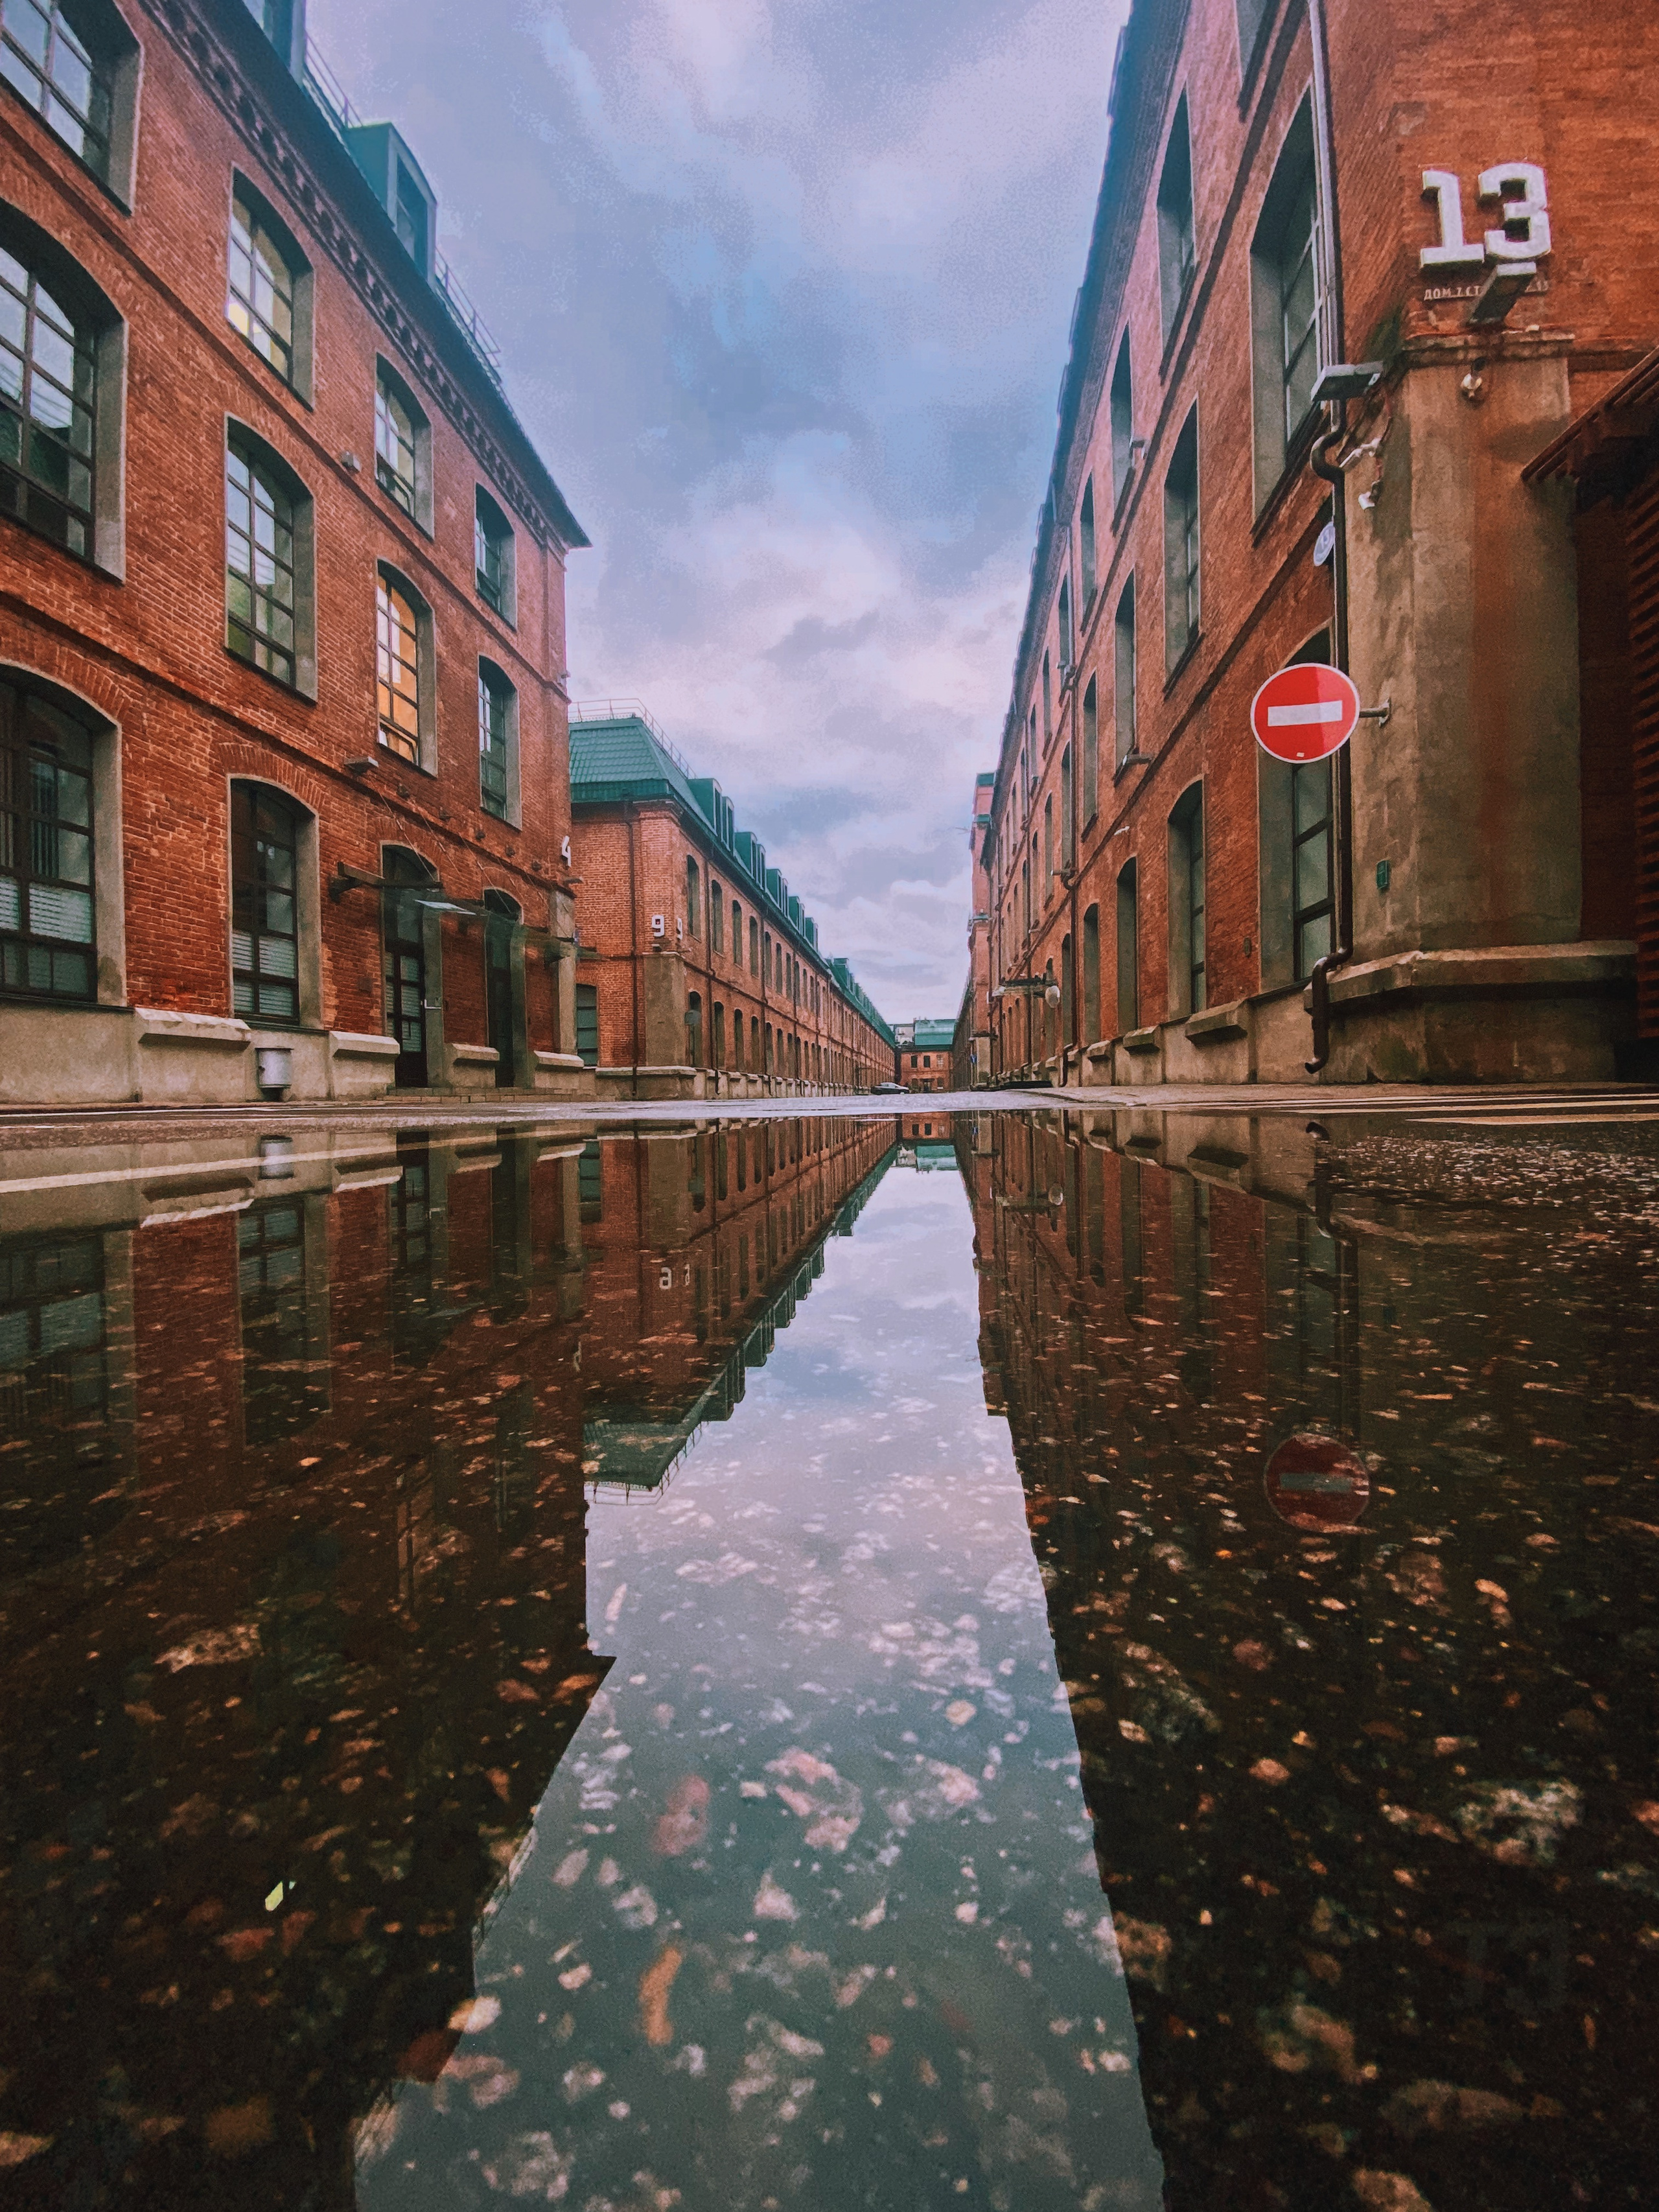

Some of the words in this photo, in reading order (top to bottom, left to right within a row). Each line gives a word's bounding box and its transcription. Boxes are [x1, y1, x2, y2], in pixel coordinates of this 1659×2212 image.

[1421, 162, 1551, 266] 13
[1424, 287, 1451, 301] ДОМ
[561, 835, 572, 867] 4
[651, 914, 665, 937] 9
